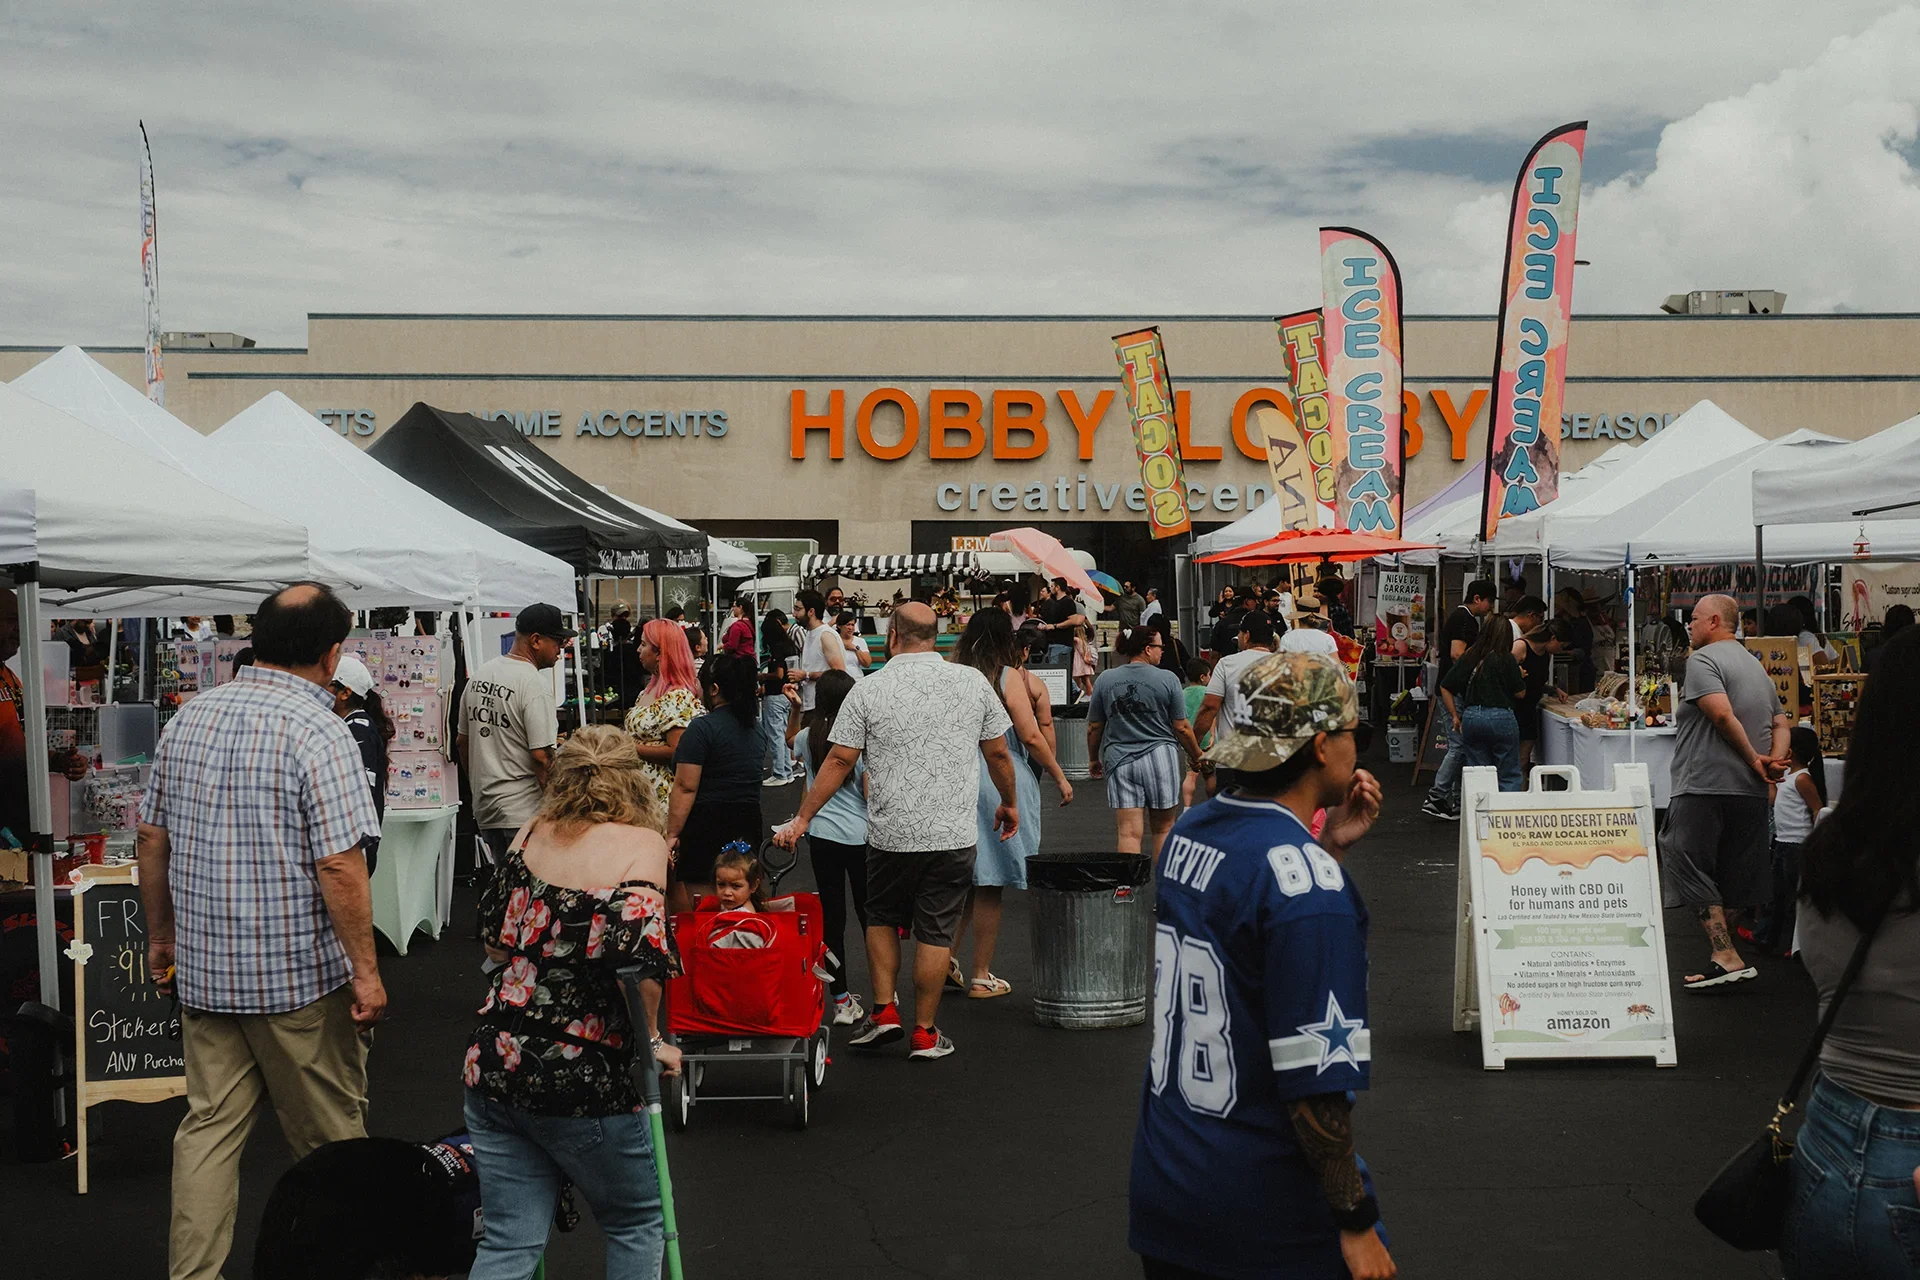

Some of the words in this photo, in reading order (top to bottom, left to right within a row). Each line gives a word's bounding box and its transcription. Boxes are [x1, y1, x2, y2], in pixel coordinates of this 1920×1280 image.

[1342, 256, 1382, 359] ICE
[467, 409, 562, 437] ME
[576, 409, 729, 438] ACCENTS
[790, 387, 1116, 461] HOBBY
[1175, 387, 1490, 461] LOY
[1344, 372, 1396, 532] CREAM
[936, 474, 1147, 512] creative
[1187, 482, 1273, 512] cen
[952, 537, 991, 552] LEM
[1384, 584, 1420, 593] GARRAFA
[1386, 574, 1408, 584] NIEVE
[1409, 575, 1419, 584] DE
[1488, 815, 1511, 828] NEW
[1515, 814, 1557, 828] MEXICO
[1561, 813, 1602, 827] DESERT
[1606, 812, 1637, 826] FARM
[1497, 831, 1526, 839] 100%
[1529, 831, 1552, 839] RAW
[1555, 830, 1588, 838] LOCAL
[1591, 829, 1628, 837] HONEY
[1163, 834, 1226, 892] IRVIN
[1267, 842, 1344, 897] 88
[1511, 885, 1547, 898] Honey
[1551, 884, 1575, 895] with
[1580, 884, 1603, 895] CBD
[1607, 883, 1624, 894] Oil
[1509, 899, 1525, 910] for
[1529, 899, 1574, 909] humans
[1578, 898, 1599, 909] and
[1604, 898, 1628, 911] pets
[98, 899, 143, 937] FR
[119, 950, 144, 984] 91
[1596, 959, 1626, 967] Enzymes
[1568, 981, 1581, 989] high
[89, 1009, 180, 1043] Stickers
[1547, 1018, 1610, 1030] amazon
[105, 1050, 137, 1074] ANY
[144, 1053, 185, 1070] Purcha
